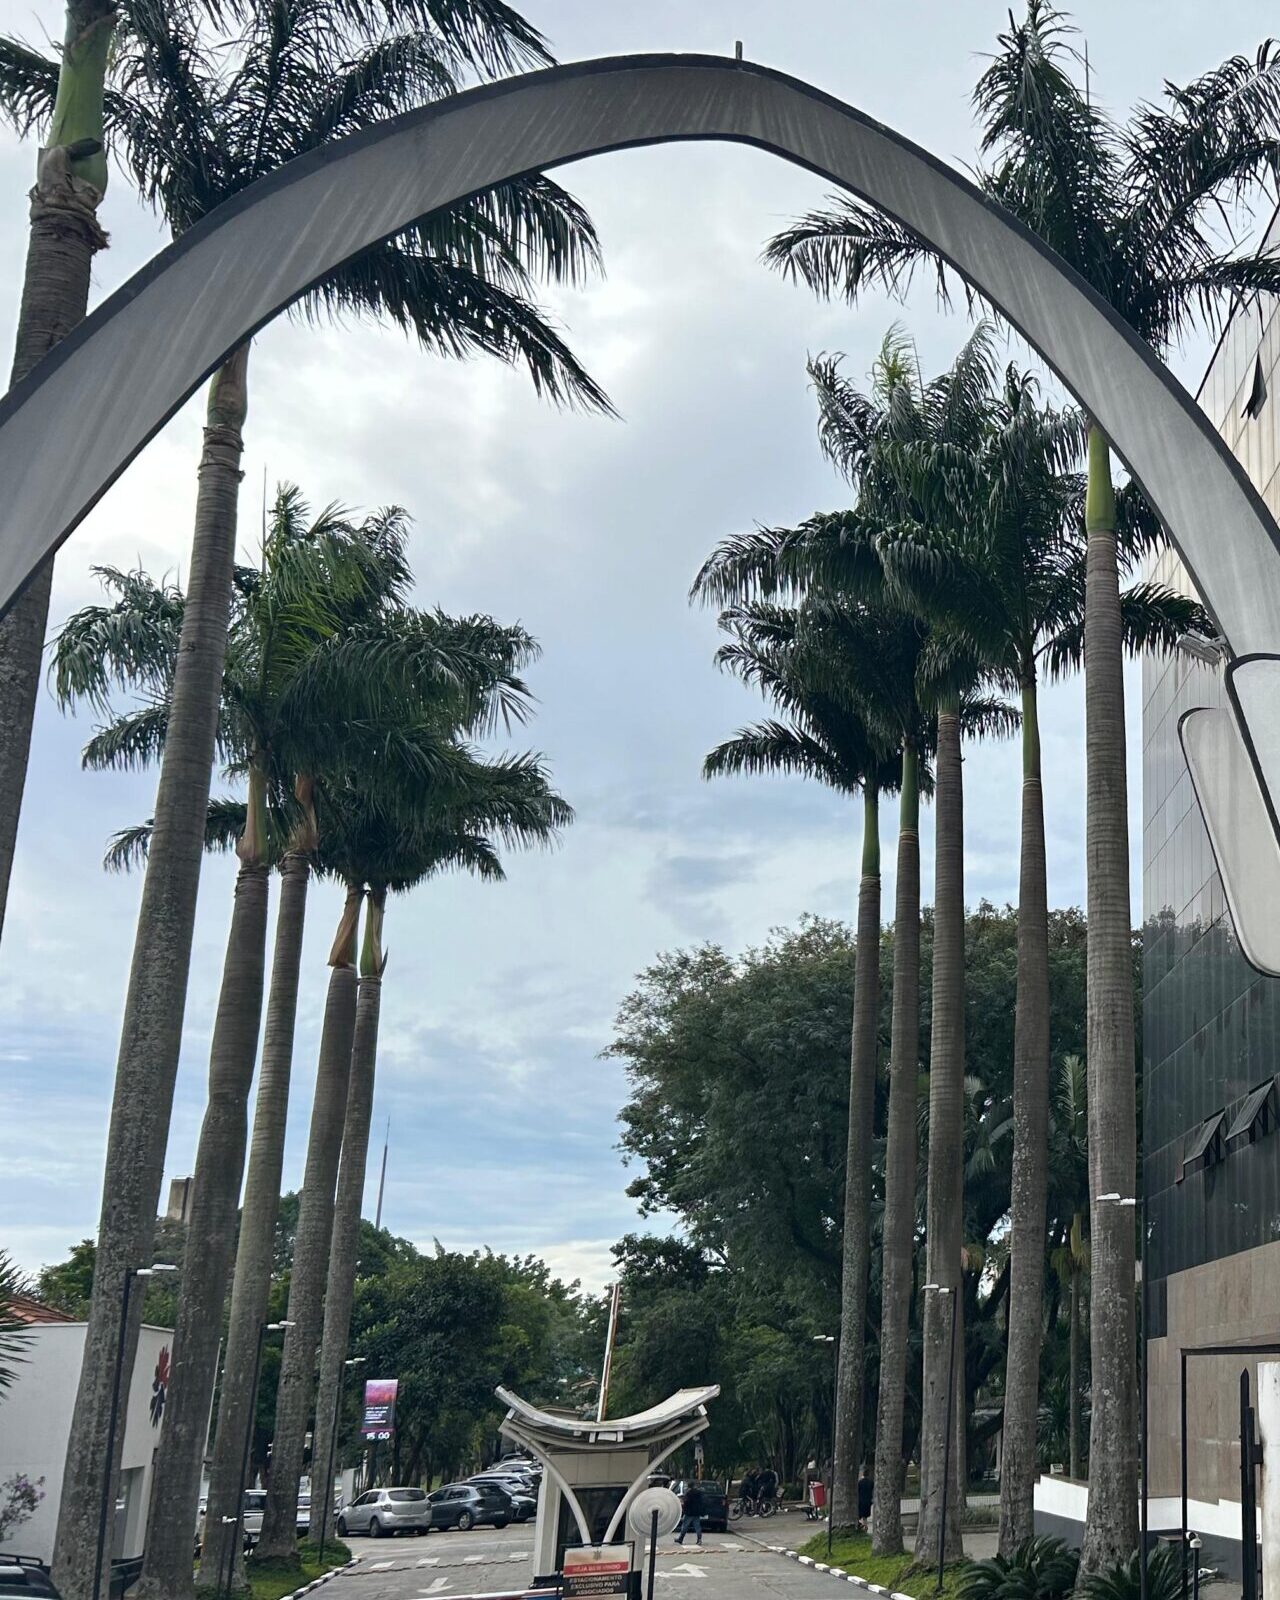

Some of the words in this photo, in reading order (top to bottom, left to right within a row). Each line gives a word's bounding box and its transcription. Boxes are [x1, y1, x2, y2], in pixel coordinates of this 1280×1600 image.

[569, 1574, 622, 1583] ESTACIONAMENTO
[570, 1582, 603, 1590] EXCLUSIVO
[576, 1587, 614, 1595] ASSOCIADOS
